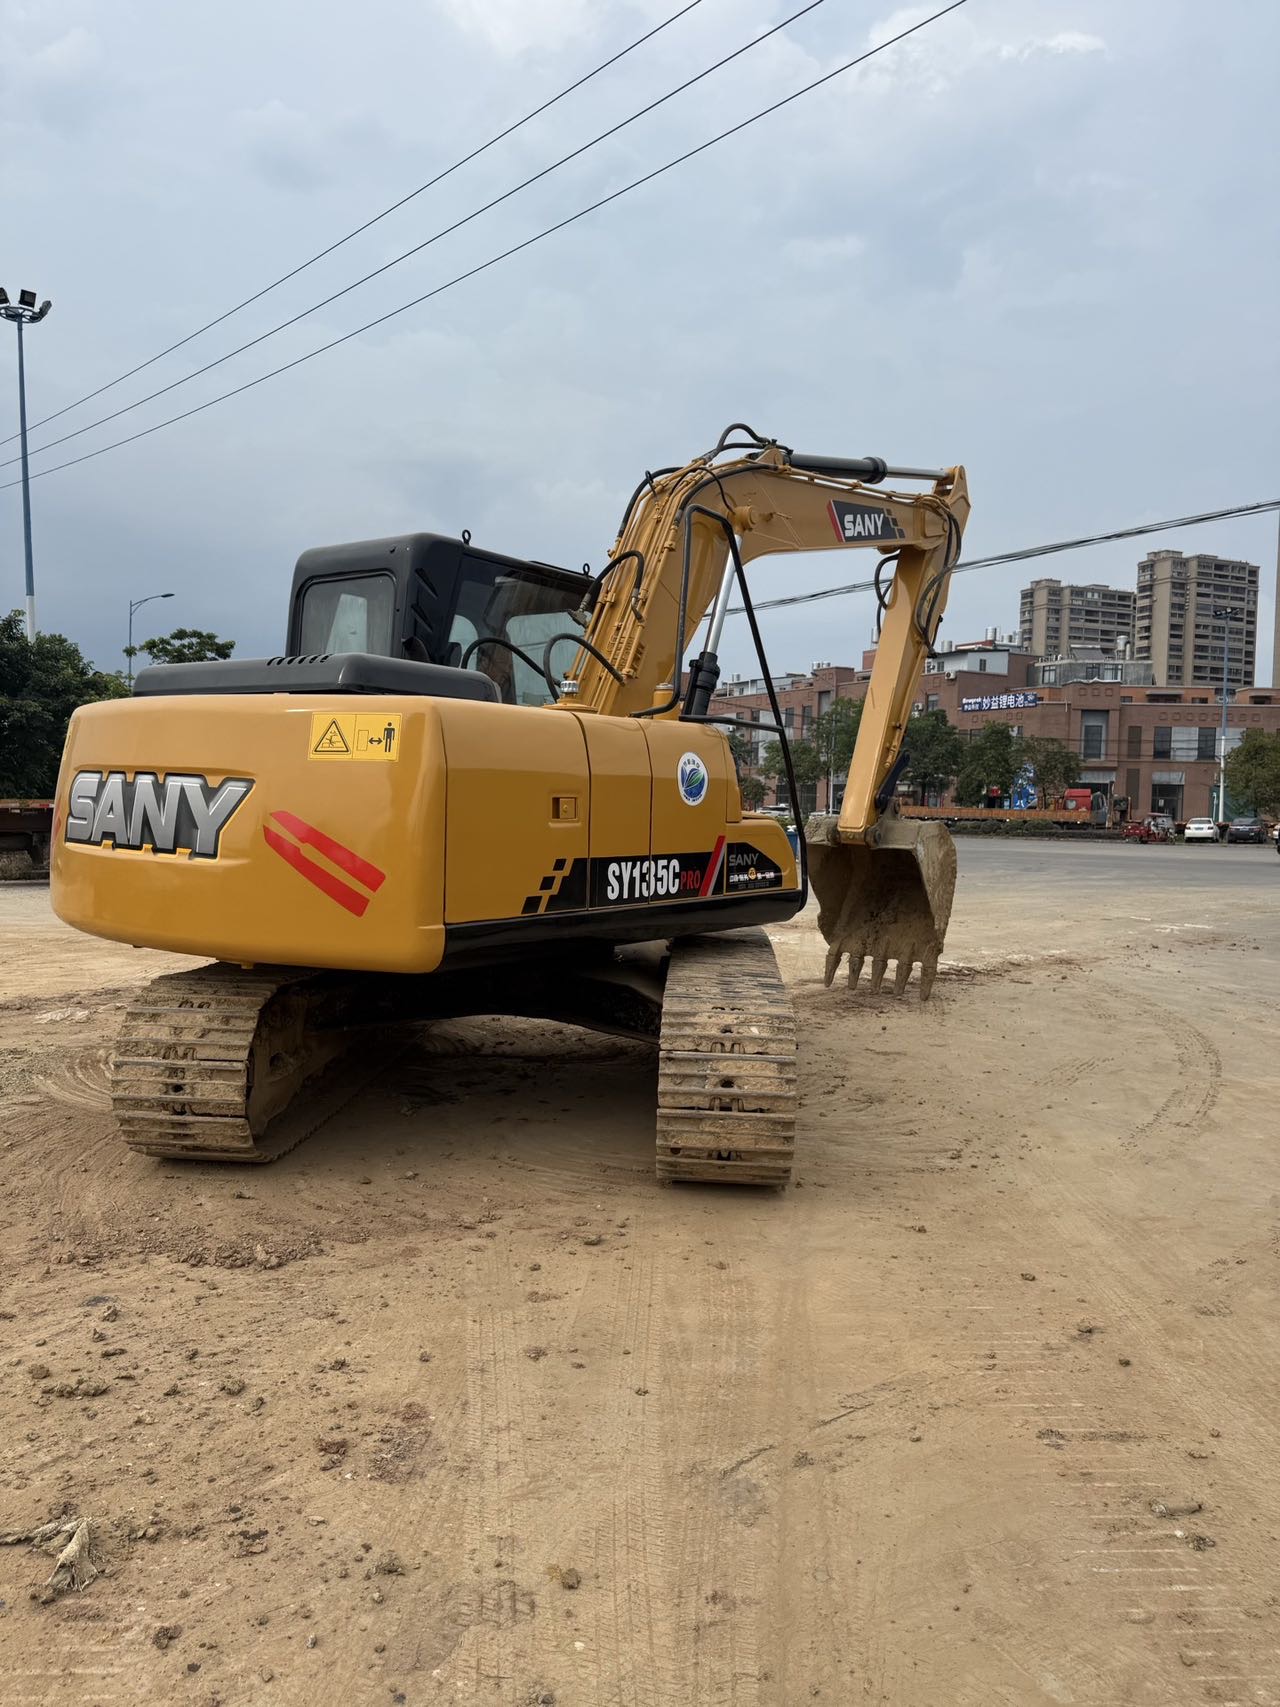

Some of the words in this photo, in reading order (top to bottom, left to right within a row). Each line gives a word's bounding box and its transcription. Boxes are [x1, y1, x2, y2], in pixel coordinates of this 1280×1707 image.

[844, 513, 884, 537] SANY
[66, 771, 254, 856] SANY
[729, 853, 759, 867] SANY
[607, 859, 680, 900] SY135C
[680, 870, 701, 890] PRO
